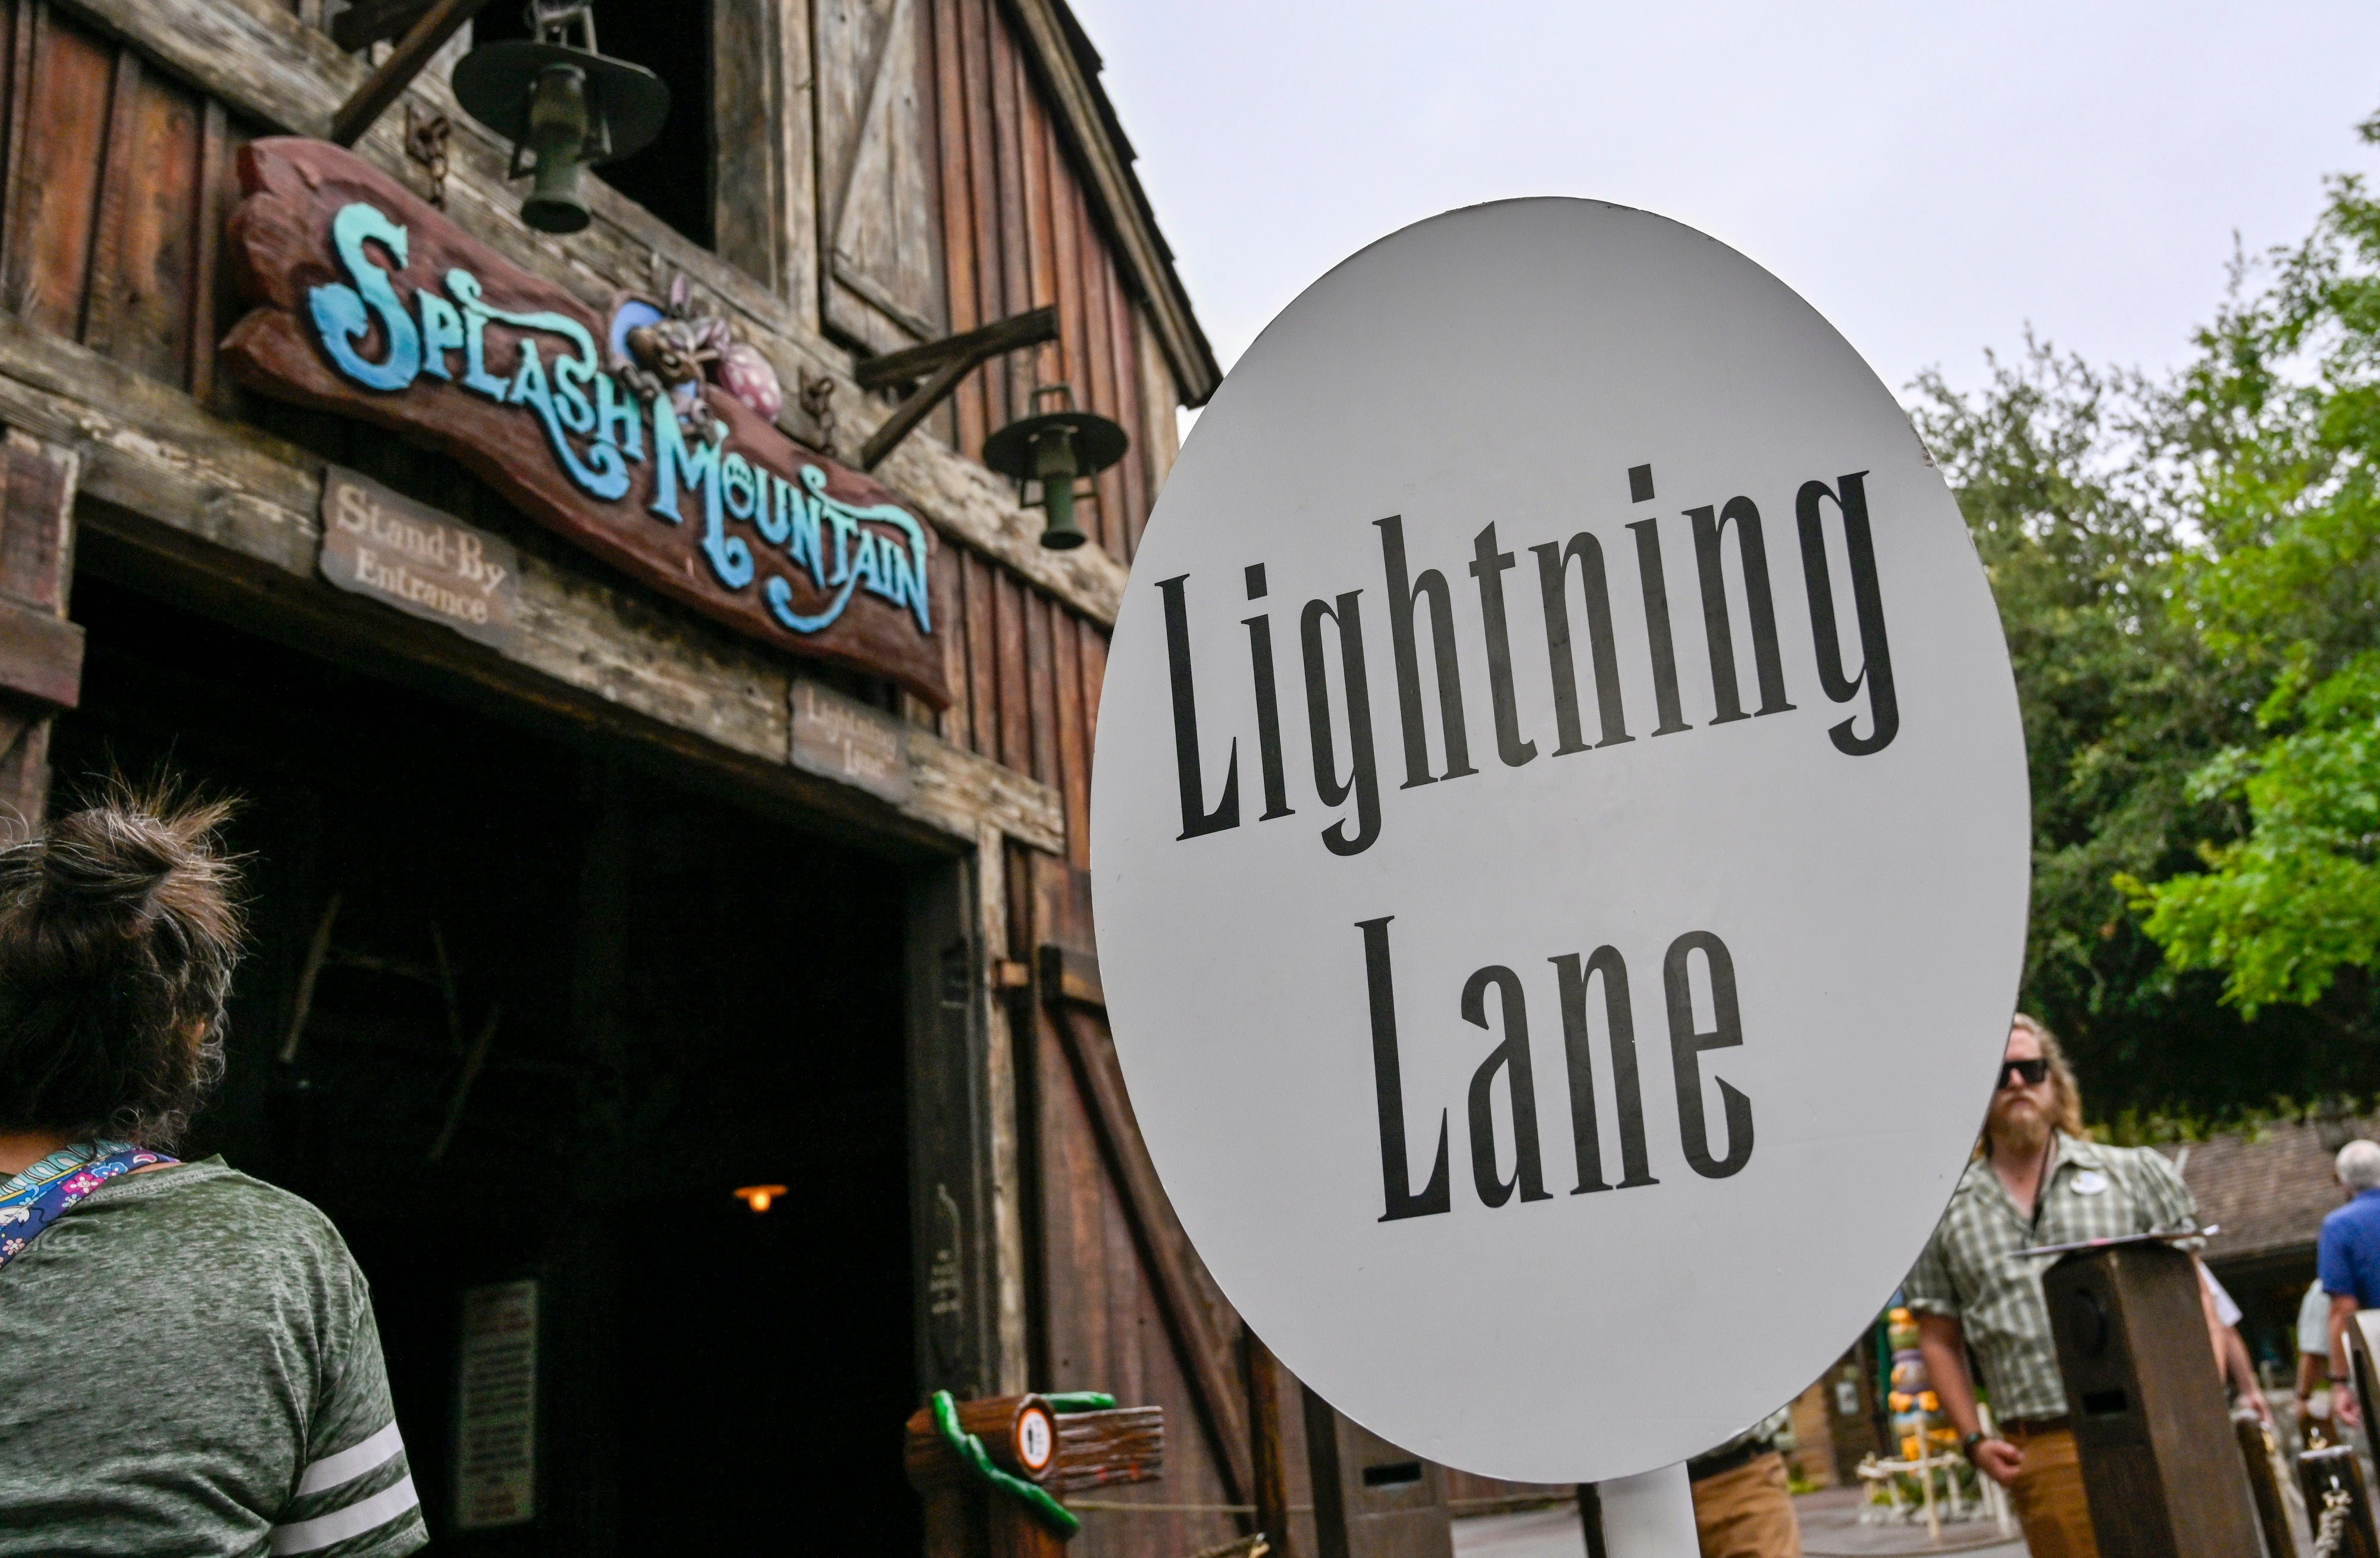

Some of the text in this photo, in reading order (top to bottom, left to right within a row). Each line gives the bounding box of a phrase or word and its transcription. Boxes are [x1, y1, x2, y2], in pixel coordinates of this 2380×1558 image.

[309, 202, 932, 634] SPLASH MOUNTAIN
[356, 547, 488, 624] Entrance
[1154, 463, 1899, 856] Lightning
[1354, 915, 1754, 1223] Lane
